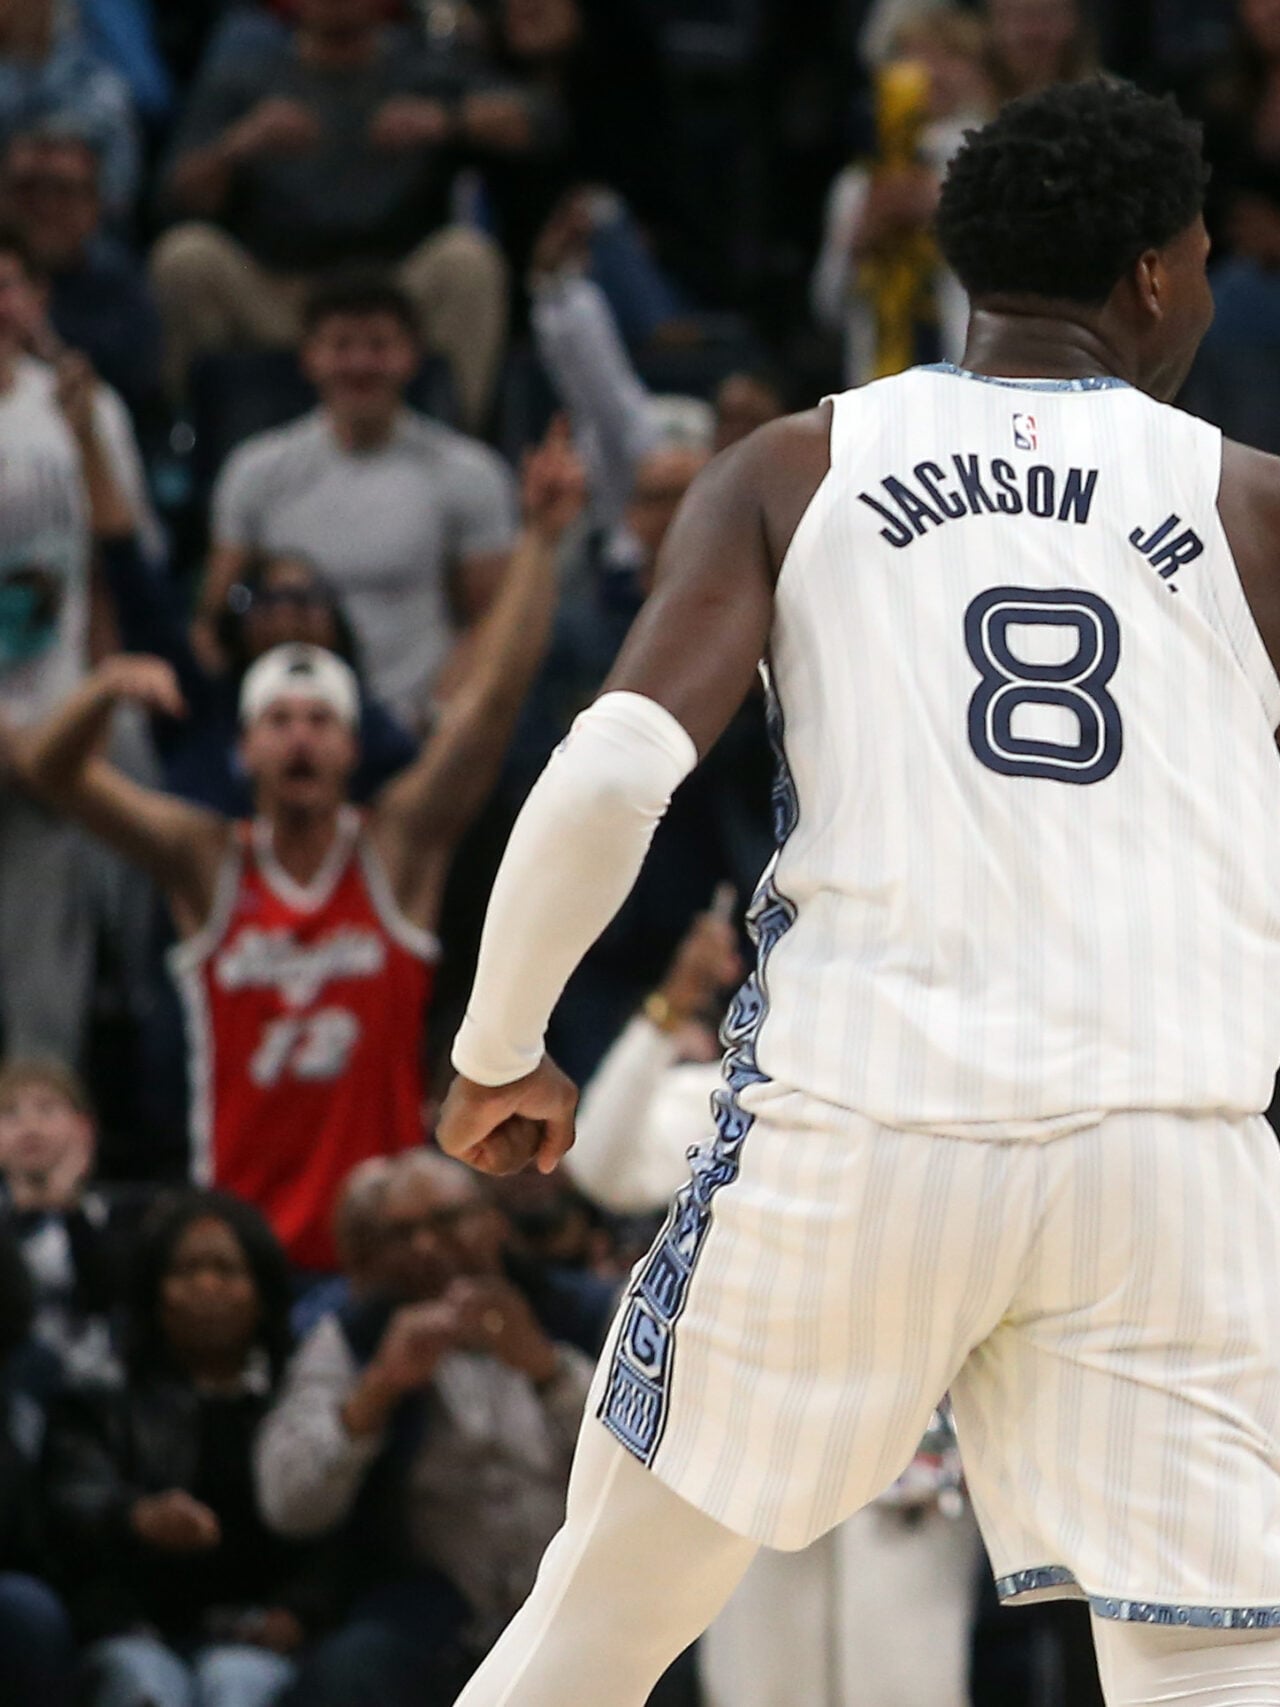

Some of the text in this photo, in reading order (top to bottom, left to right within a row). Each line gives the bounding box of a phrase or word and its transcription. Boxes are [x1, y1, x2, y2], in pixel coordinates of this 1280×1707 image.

[857, 453, 1205, 594] JACKSON JR.
[963, 585, 1123, 786] 8
